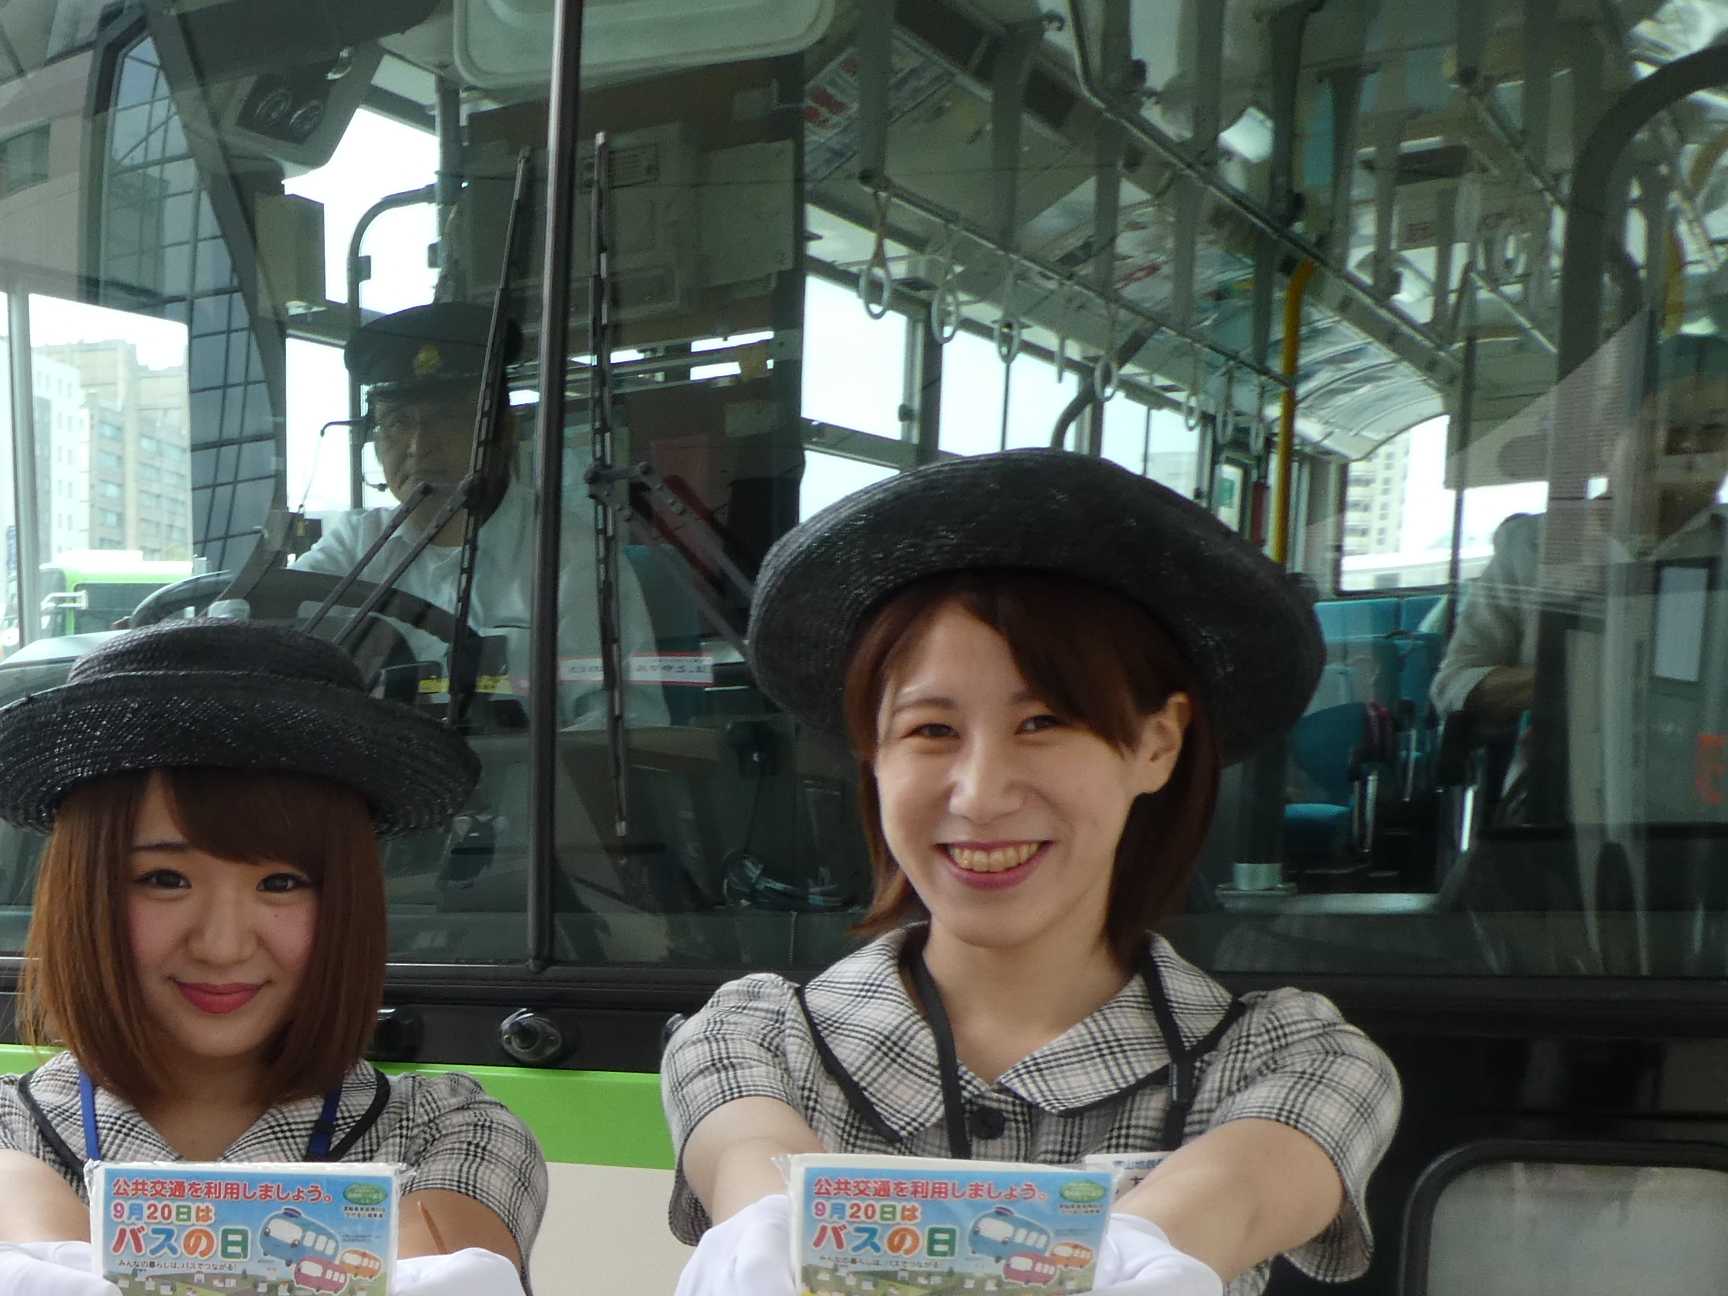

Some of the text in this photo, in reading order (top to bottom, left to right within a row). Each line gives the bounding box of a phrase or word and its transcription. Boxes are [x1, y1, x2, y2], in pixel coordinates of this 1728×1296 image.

[112, 1177, 333, 1203] 公共交通を利用しましょう。
[813, 1177, 1048, 1201] 公共交通を利用しましょう。
[112, 1201, 214, 1223] 9月20日は
[813, 1200, 919, 1222] 9月20日は
[111, 1225, 250, 1260] バスの日
[812, 1223, 957, 1258] バスの日
